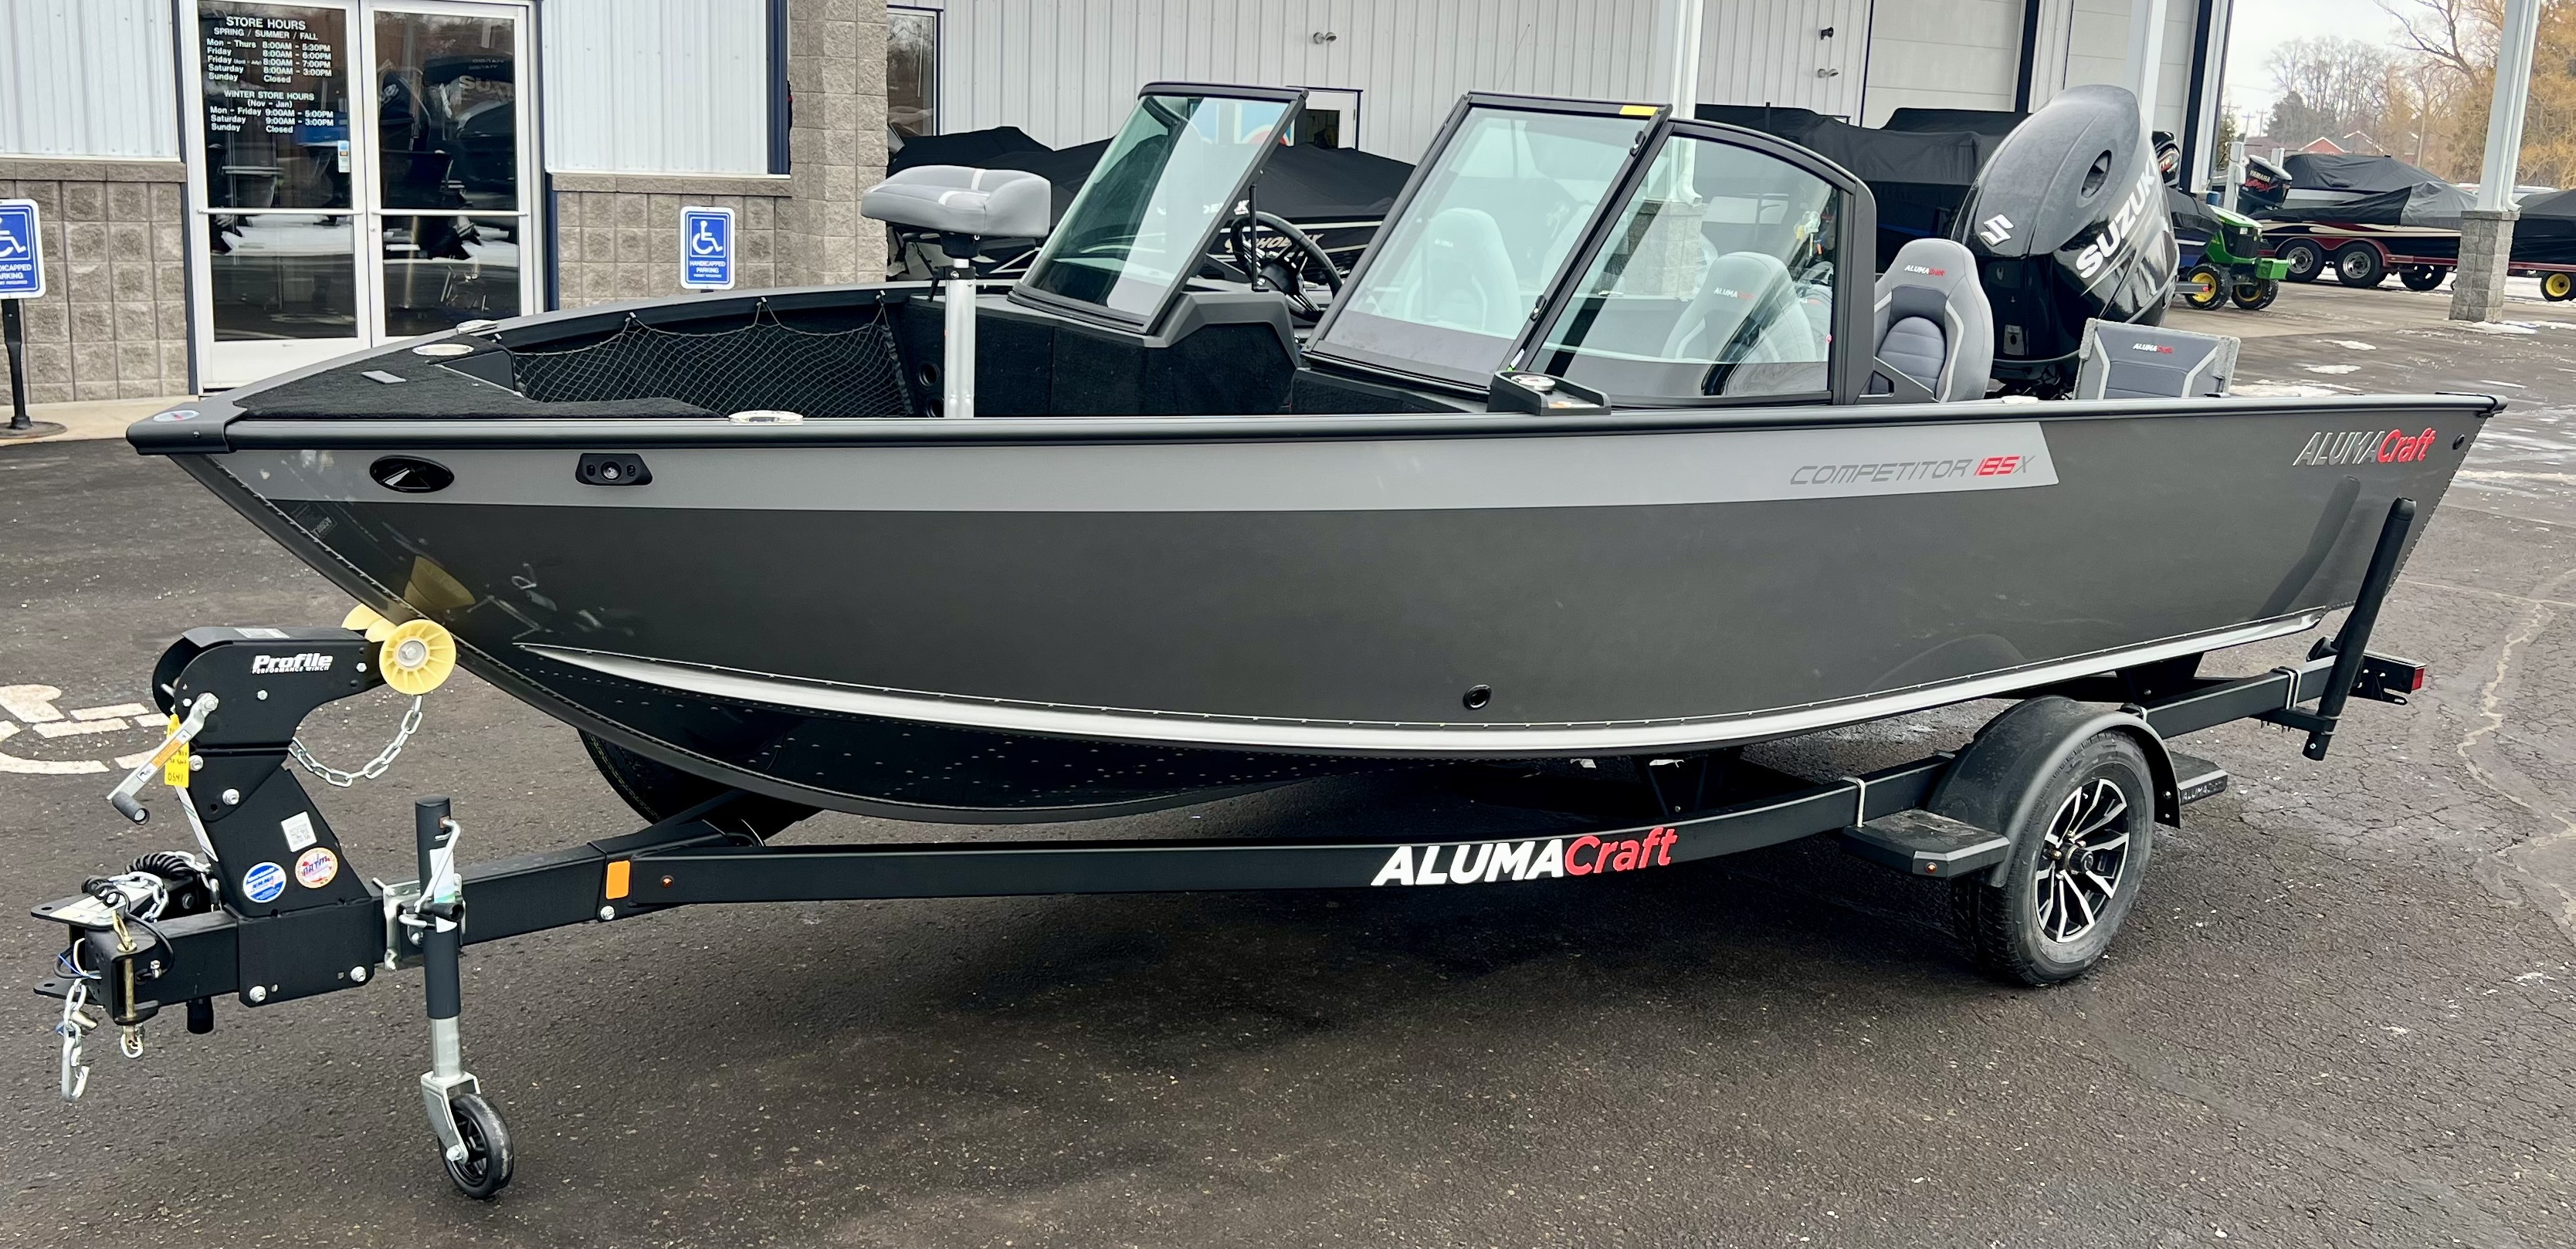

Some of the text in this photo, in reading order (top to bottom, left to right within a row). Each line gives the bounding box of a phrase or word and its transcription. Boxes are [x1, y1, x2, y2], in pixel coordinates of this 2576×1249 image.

[226, 16, 306, 30] STORE HOURS
[214, 27, 244, 36] SPRING
[255, 29, 290, 39] SUMMER
[300, 32, 318, 41] FALL
[207, 38, 224, 46] Mon
[234, 39, 256, 48] Thurs
[263, 41, 292, 49] 8:00AM
[302, 43, 330, 52] 5:30PM
[207, 46, 232, 56] Friday
[303, 52, 331, 60] 6:00PM
[208, 55, 232, 64] Friday
[208, 63, 244, 73] Saturday
[263, 66, 293, 75] 8:00AM
[208, 73, 291, 83] Sunday Closed
[258, 91, 283, 100] STORE
[248, 99, 265, 107] (Nov
[276, 100, 293, 108] Jan)
[238, 107, 261, 117] Friday
[210, 114, 246, 124] Saturday
[212, 123, 240, 131] Sunday
[2075, 148, 2157, 279] SUZUKI
[1789, 459, 1973, 485] COMPETITOR
[253, 653, 334, 669] Profile
[1370, 828, 1678, 886] ALUMACraft
